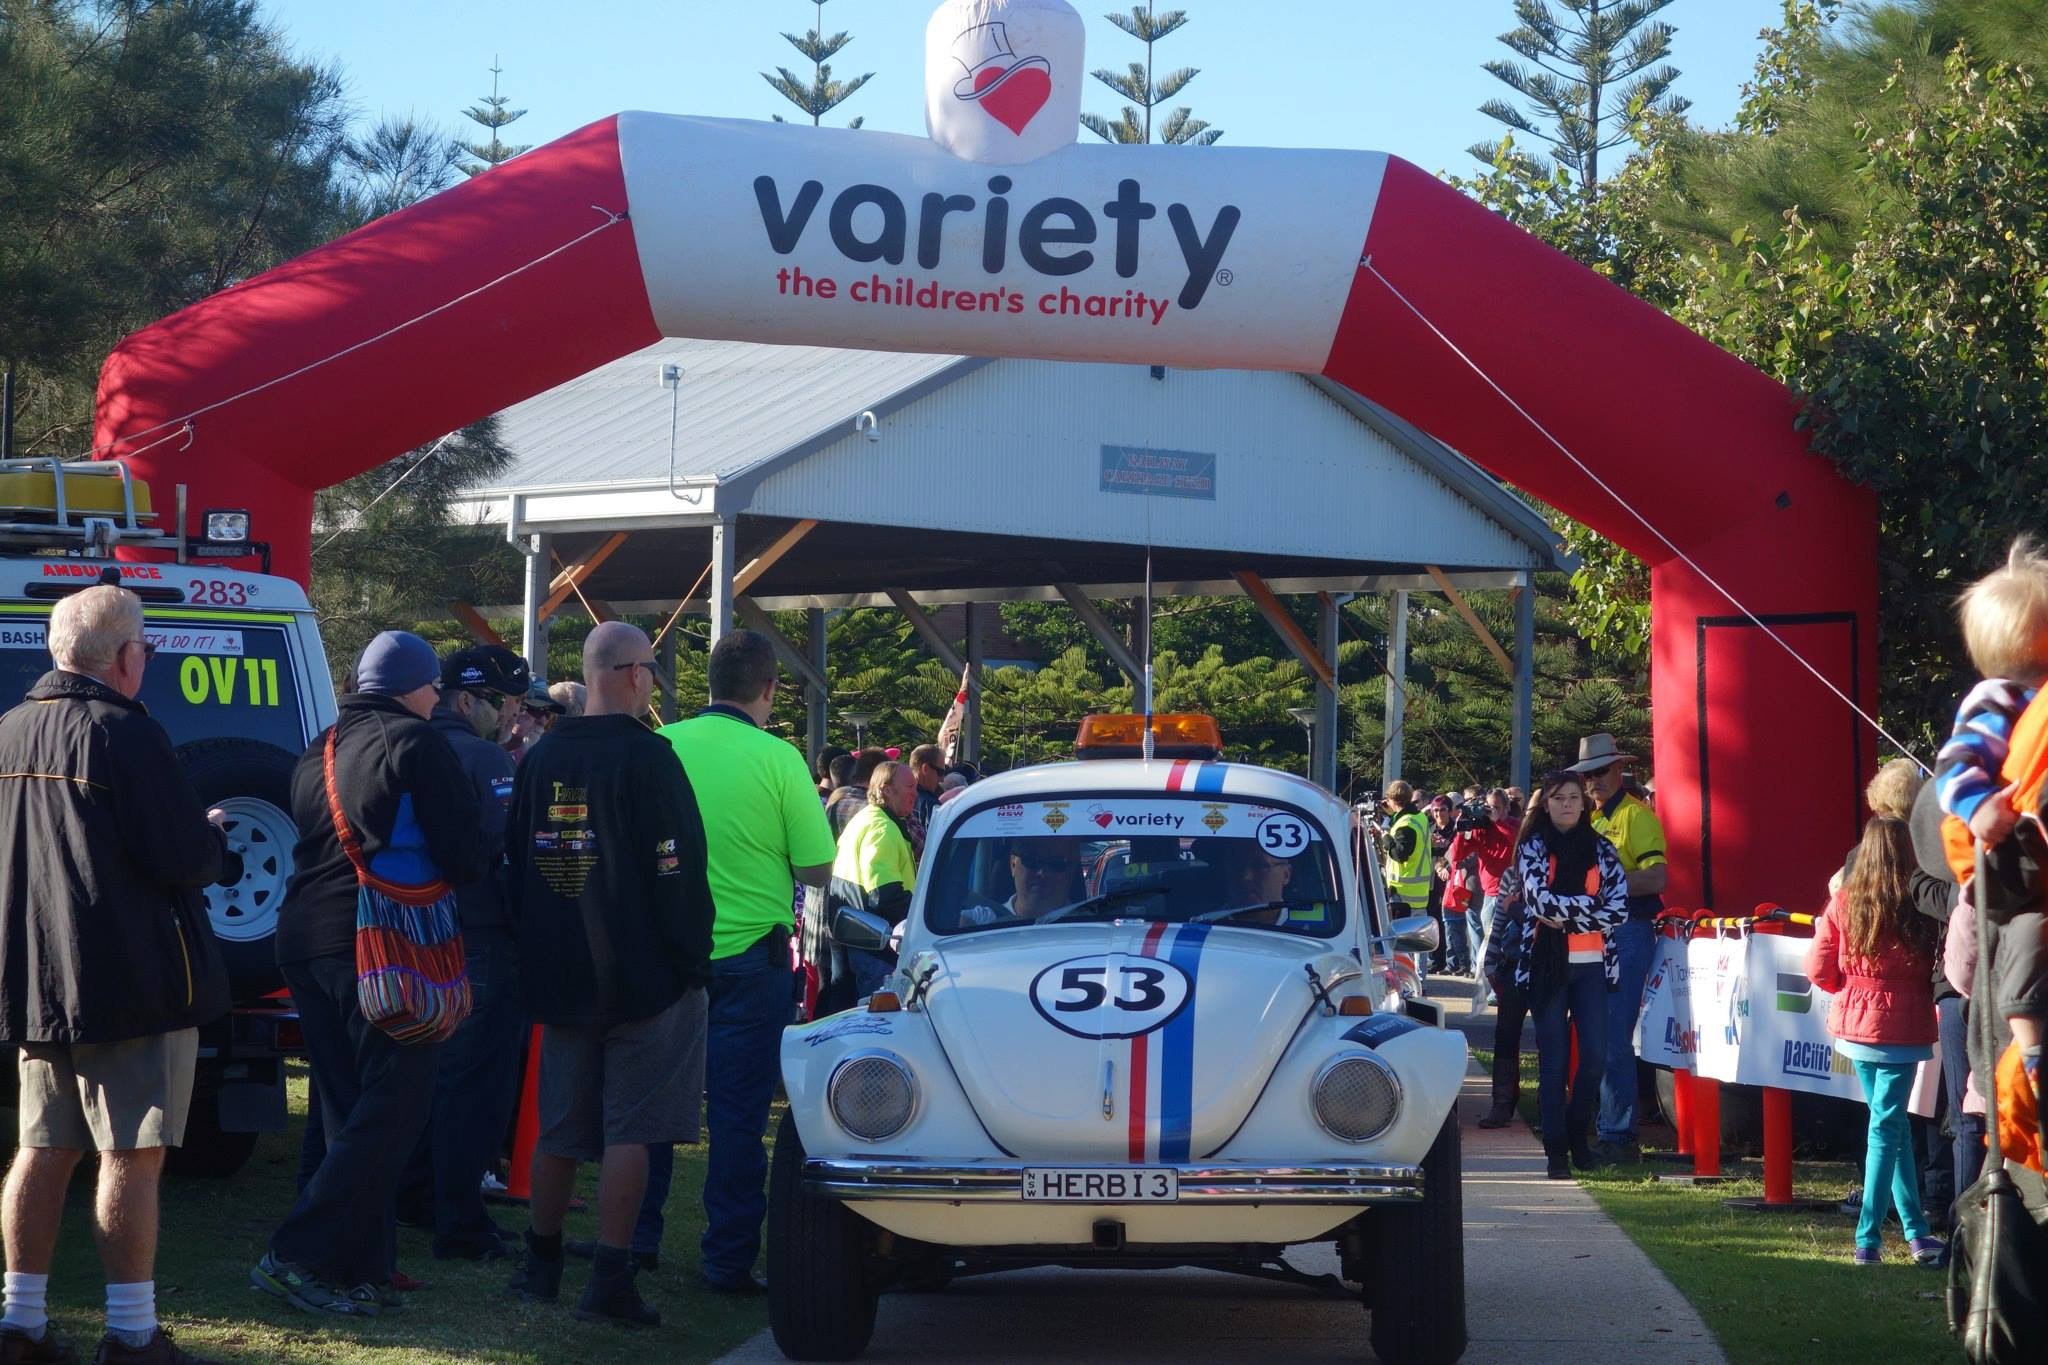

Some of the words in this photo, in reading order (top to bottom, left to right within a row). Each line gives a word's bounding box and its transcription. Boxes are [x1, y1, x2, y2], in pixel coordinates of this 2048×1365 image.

[753, 174, 1241, 310] variety
[776, 266, 837, 299] the
[849, 274, 1025, 314] children's
[1038, 286, 1170, 326] charity
[189, 580, 247, 606] 283
[2, 632, 45, 645] BASH
[171, 635, 191, 649] DO
[1115, 812, 1185, 830] variety
[1265, 824, 1303, 849] 53
[1055, 966, 1166, 1012] 53
[1043, 1174, 1170, 1198] HERBI3
